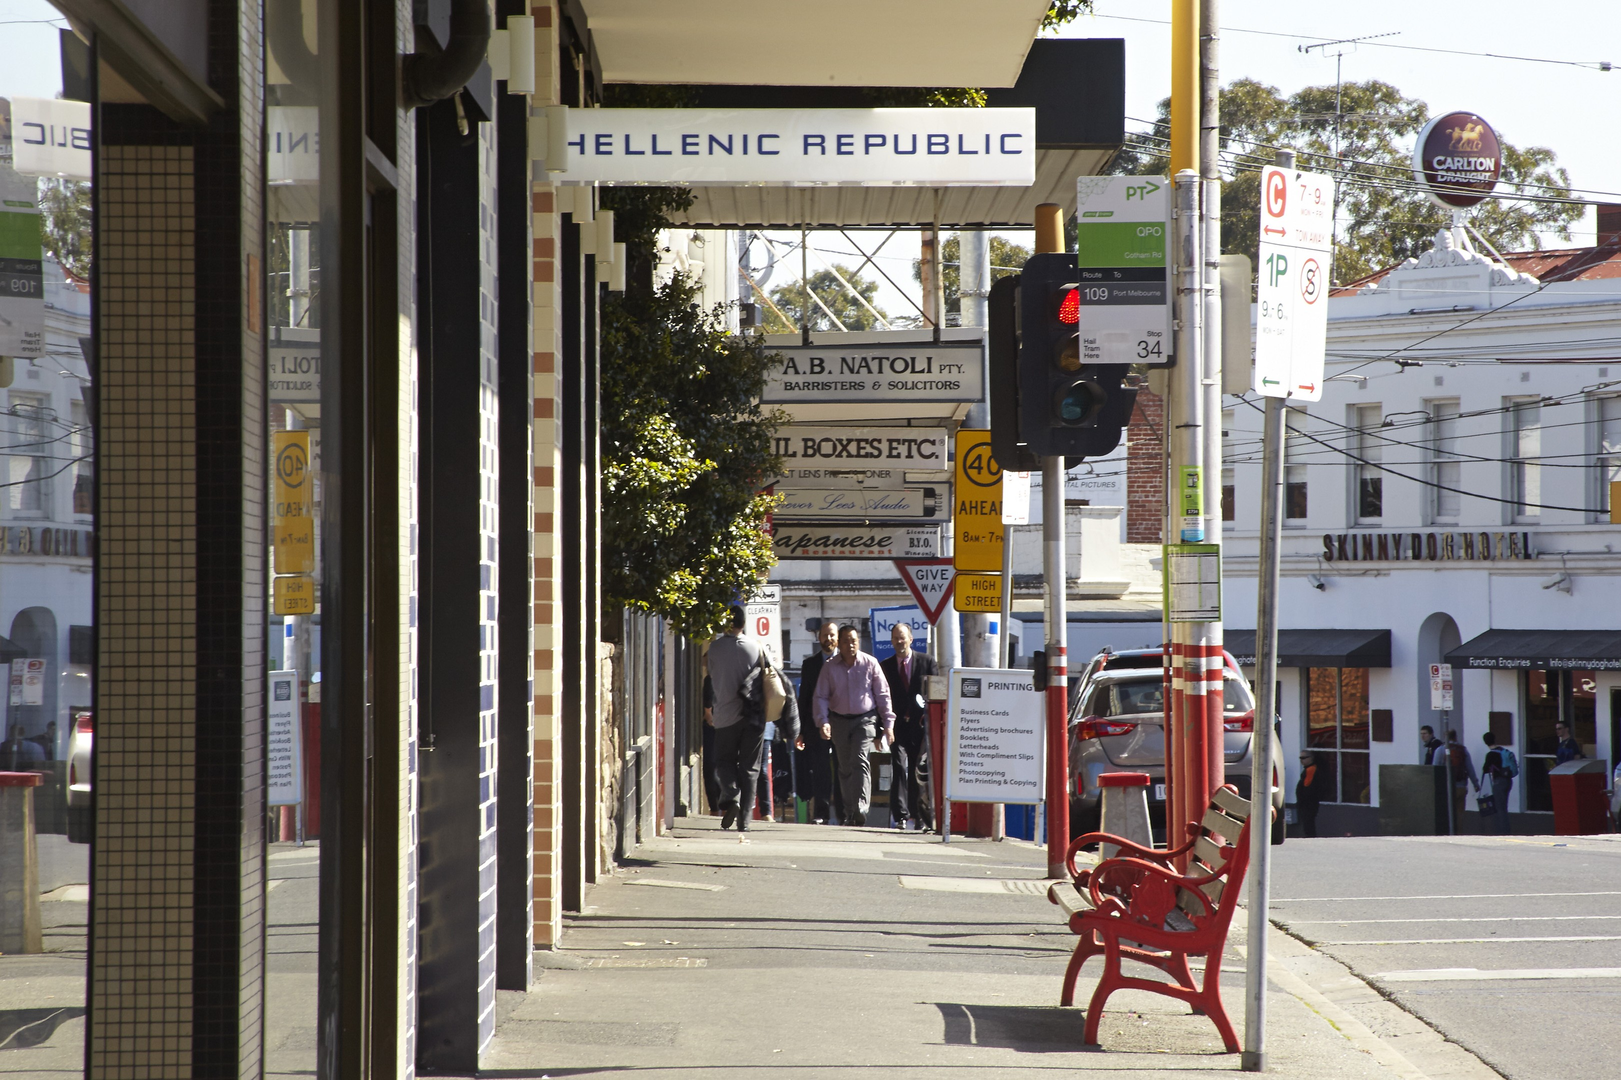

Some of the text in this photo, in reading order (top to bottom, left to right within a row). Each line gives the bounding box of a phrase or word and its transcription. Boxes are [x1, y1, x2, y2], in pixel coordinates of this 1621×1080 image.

[568, 133, 1023, 156] HELLENIC REPUBLIC
[1433, 155, 1495, 171] CARLTON
[1437, 171, 1492, 183] DRAUGHT
[1266, 252, 1288, 288] 1P
[1084, 287, 1109, 301] 109
[1137, 340, 1163, 359] 34
[782, 356, 965, 375] A.B. NATOLI PTY.
[784, 380, 960, 391] BARRISTERS & SOLICITORS
[802, 437, 882, 459] BOXES
[886, 438, 939, 460] ETC.
[968, 453, 1000, 476] 40
[798, 470, 821, 479] LENS
[818, 493, 856, 510] Lees
[860, 494, 910, 511] Audio
[909, 537, 932, 549] B.Y.O.
[1322, 531, 1533, 562] SKINNY DOG HOTEL
[915, 569, 949, 580] GIVE
[921, 583, 944, 592] WAY
[972, 580, 996, 591] HIGH
[965, 596, 1002, 607] STREET
[748, 607, 777, 615] CLEARWAY
[1469, 657, 1496, 667] Function
[1499, 657, 1531, 668] Enquiries
[988, 682, 1033, 691] PRINTING
[960, 717, 980, 725] Flyers
[960, 725, 999, 735] Advertising
[976, 752, 1017, 760] Compliment
[1018, 753, 1034, 761] Slips
[958, 768, 1005, 778] Photocopying
[975, 778, 1002, 786] Printing
[1009, 779, 1037, 787] Copying
